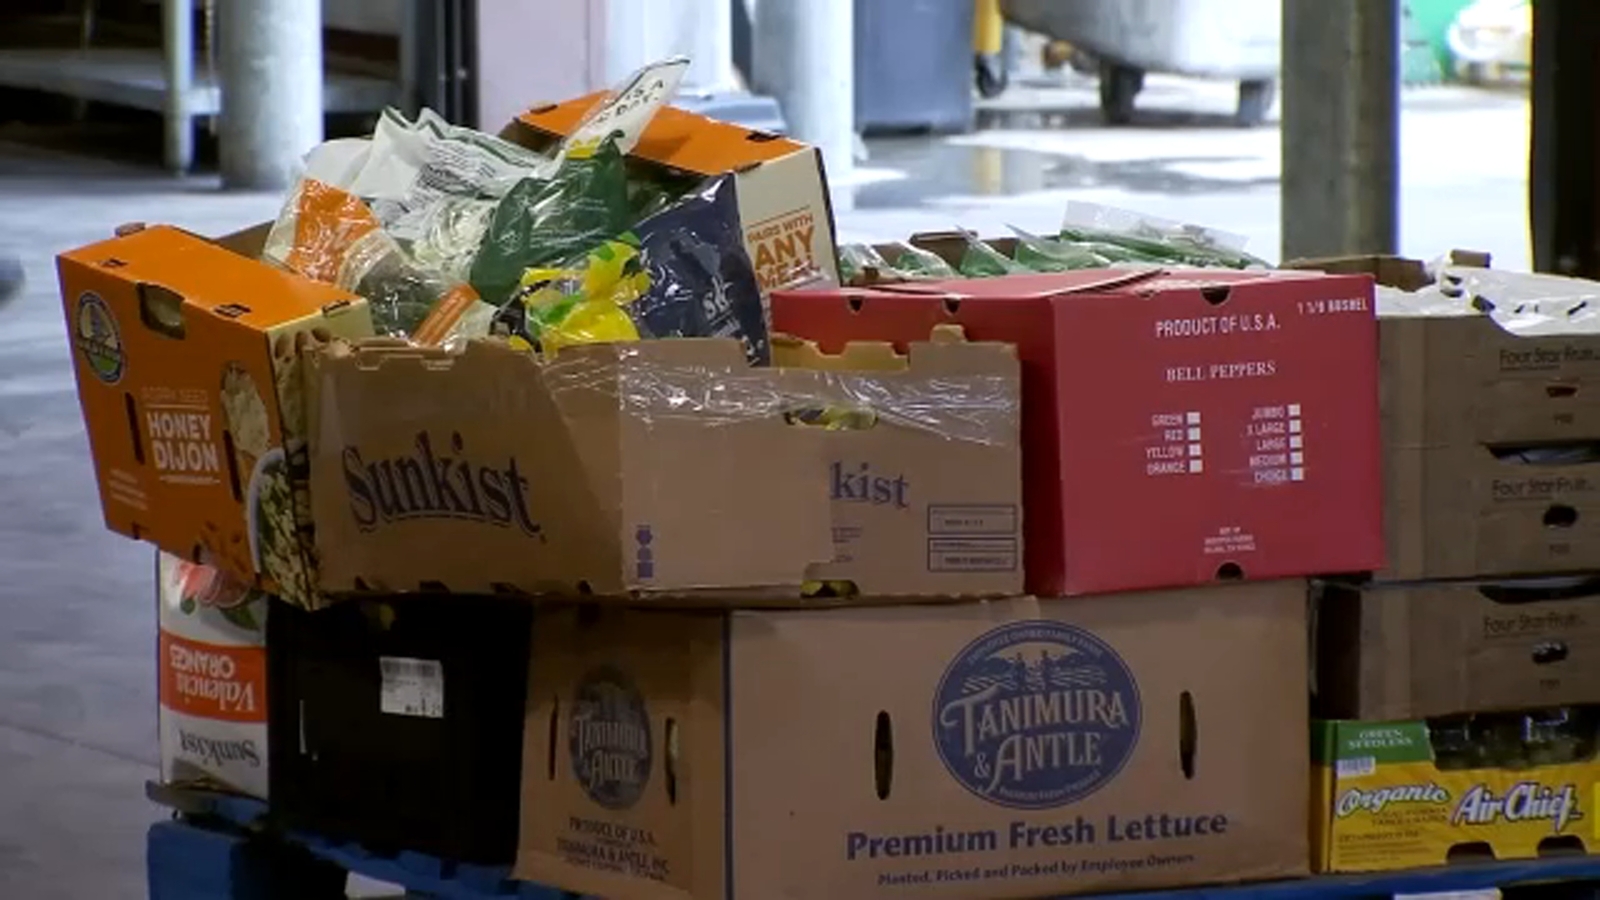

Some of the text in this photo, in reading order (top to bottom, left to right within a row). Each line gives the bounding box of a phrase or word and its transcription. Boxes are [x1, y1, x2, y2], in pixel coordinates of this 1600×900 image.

[781, 212, 813, 234] WITH
[755, 225, 815, 271] ANY
[1327, 297, 1369, 313] BUSHEL
[1156, 313, 1280, 337] PRODUCT OF U.S.A.
[1500, 349, 1531, 366] Four
[1534, 347, 1560, 363] Star
[1166, 360, 1276, 382] BELL PEPPERS
[1152, 413, 1183, 427] GREEN
[1252, 406, 1285, 421] JUMBO
[147, 411, 211, 440] HONEY
[1164, 428, 1184, 442] RED
[1255, 421, 1286, 436] LARGE
[1146, 444, 1184, 459] YELLOW
[1256, 437, 1287, 452] LARGE
[151, 440, 220, 473] DIJON
[1250, 452, 1287, 467] MEDIUM
[1147, 461, 1187, 475] ORANGE
[342, 428, 540, 537] Sunkist
[829, 461, 910, 510] kist
[1492, 480, 1525, 496] Four
[1528, 477, 1555, 493] Star
[1483, 614, 1516, 633] Four
[1519, 612, 1546, 629] Star
[174, 674, 256, 713] Valencia
[939, 683, 1130, 757] TANIMURA
[1347, 737, 1413, 750] SEEDLESS
[1359, 728, 1403, 740] GREEN
[178, 728, 261, 768] Sunkist
[589, 748, 638, 791] ANTLE
[973, 752, 992, 779] &
[980, 731, 1102, 795] ANTLE
[1335, 781, 1451, 821] Organic
[847, 811, 1229, 861] Premium Fresh Lettuce
[878, 869, 933, 888] Planted,
[935, 867, 981, 884] Picked
[983, 865, 1009, 880] and
[1011, 861, 1059, 879] Packed
[1062, 860, 1078, 876] by
[1081, 855, 1145, 874] Employee
